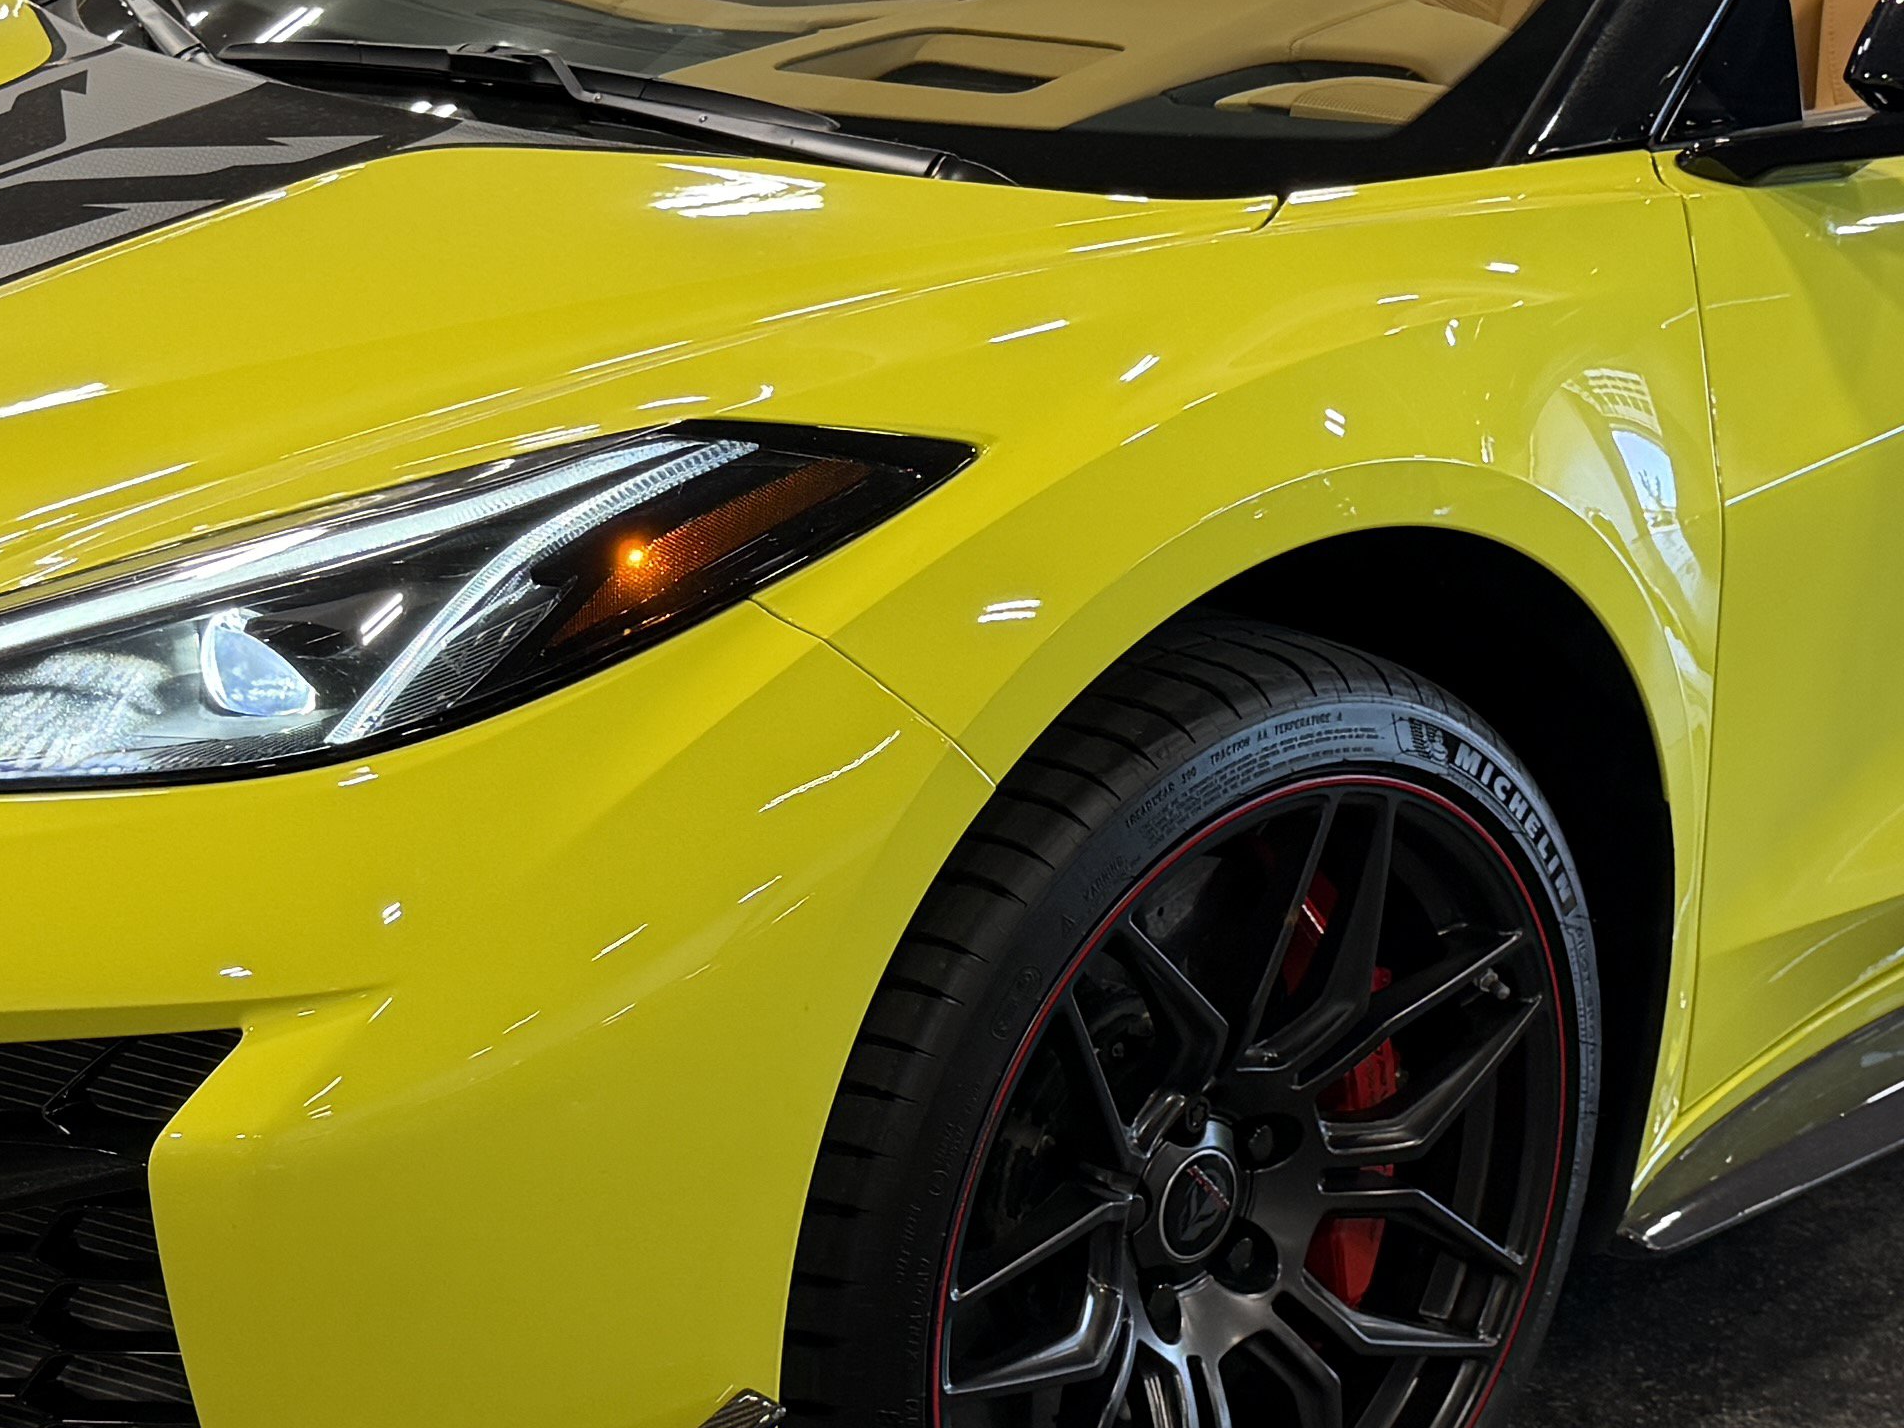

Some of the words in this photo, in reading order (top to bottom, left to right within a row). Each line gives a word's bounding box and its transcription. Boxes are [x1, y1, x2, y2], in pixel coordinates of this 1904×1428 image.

[1210, 736, 1250, 766] TRACTION
[1274, 712, 1331, 736] TEMPERATURE
[1454, 742, 1572, 903] MICHELIN
